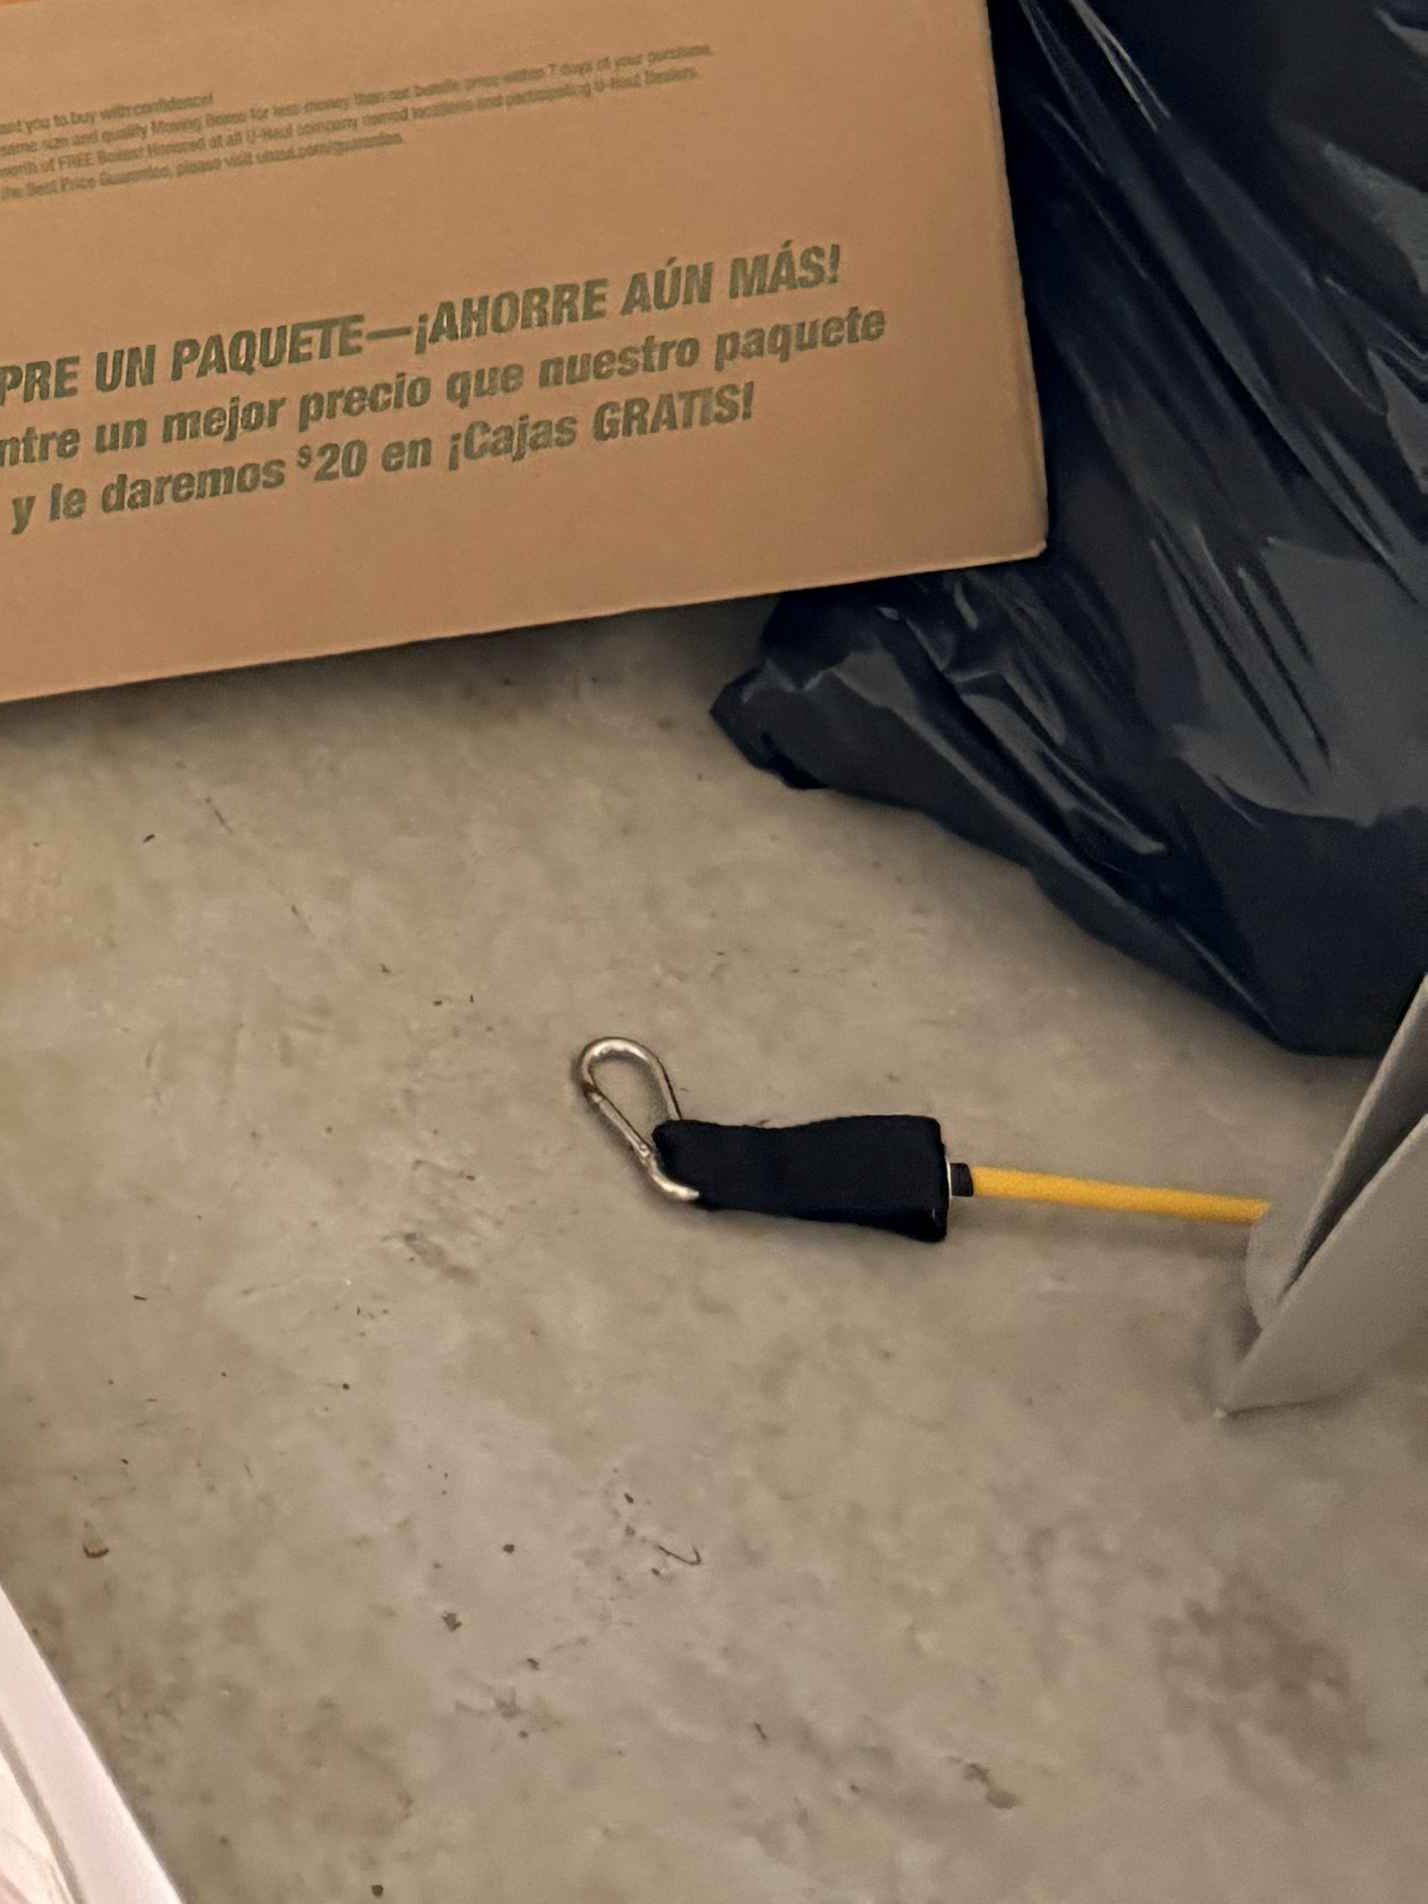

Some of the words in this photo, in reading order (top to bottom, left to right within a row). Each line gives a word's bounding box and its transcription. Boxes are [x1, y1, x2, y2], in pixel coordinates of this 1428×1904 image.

[94, 344, 156, 392] UN
[620, 257, 714, 316] AÚN
[728, 239, 841, 299] MÁS!
[95, 417, 147, 454] un
[162, 395, 286, 443] mejor
[299, 372, 431, 432] precio
[445, 361, 524, 409] que
[539, 334, 699, 389] nuestro
[714, 304, 886, 372] paquete
[11, 495, 36, 535] y
[50, 482, 85, 521] le
[101, 458, 286, 514] daremos
[297, 438, 368, 482] $20
[381, 438, 432, 472] en
[448, 413, 577, 471] ¡Cajas
[592, 380, 754, 442] GRATIS!
